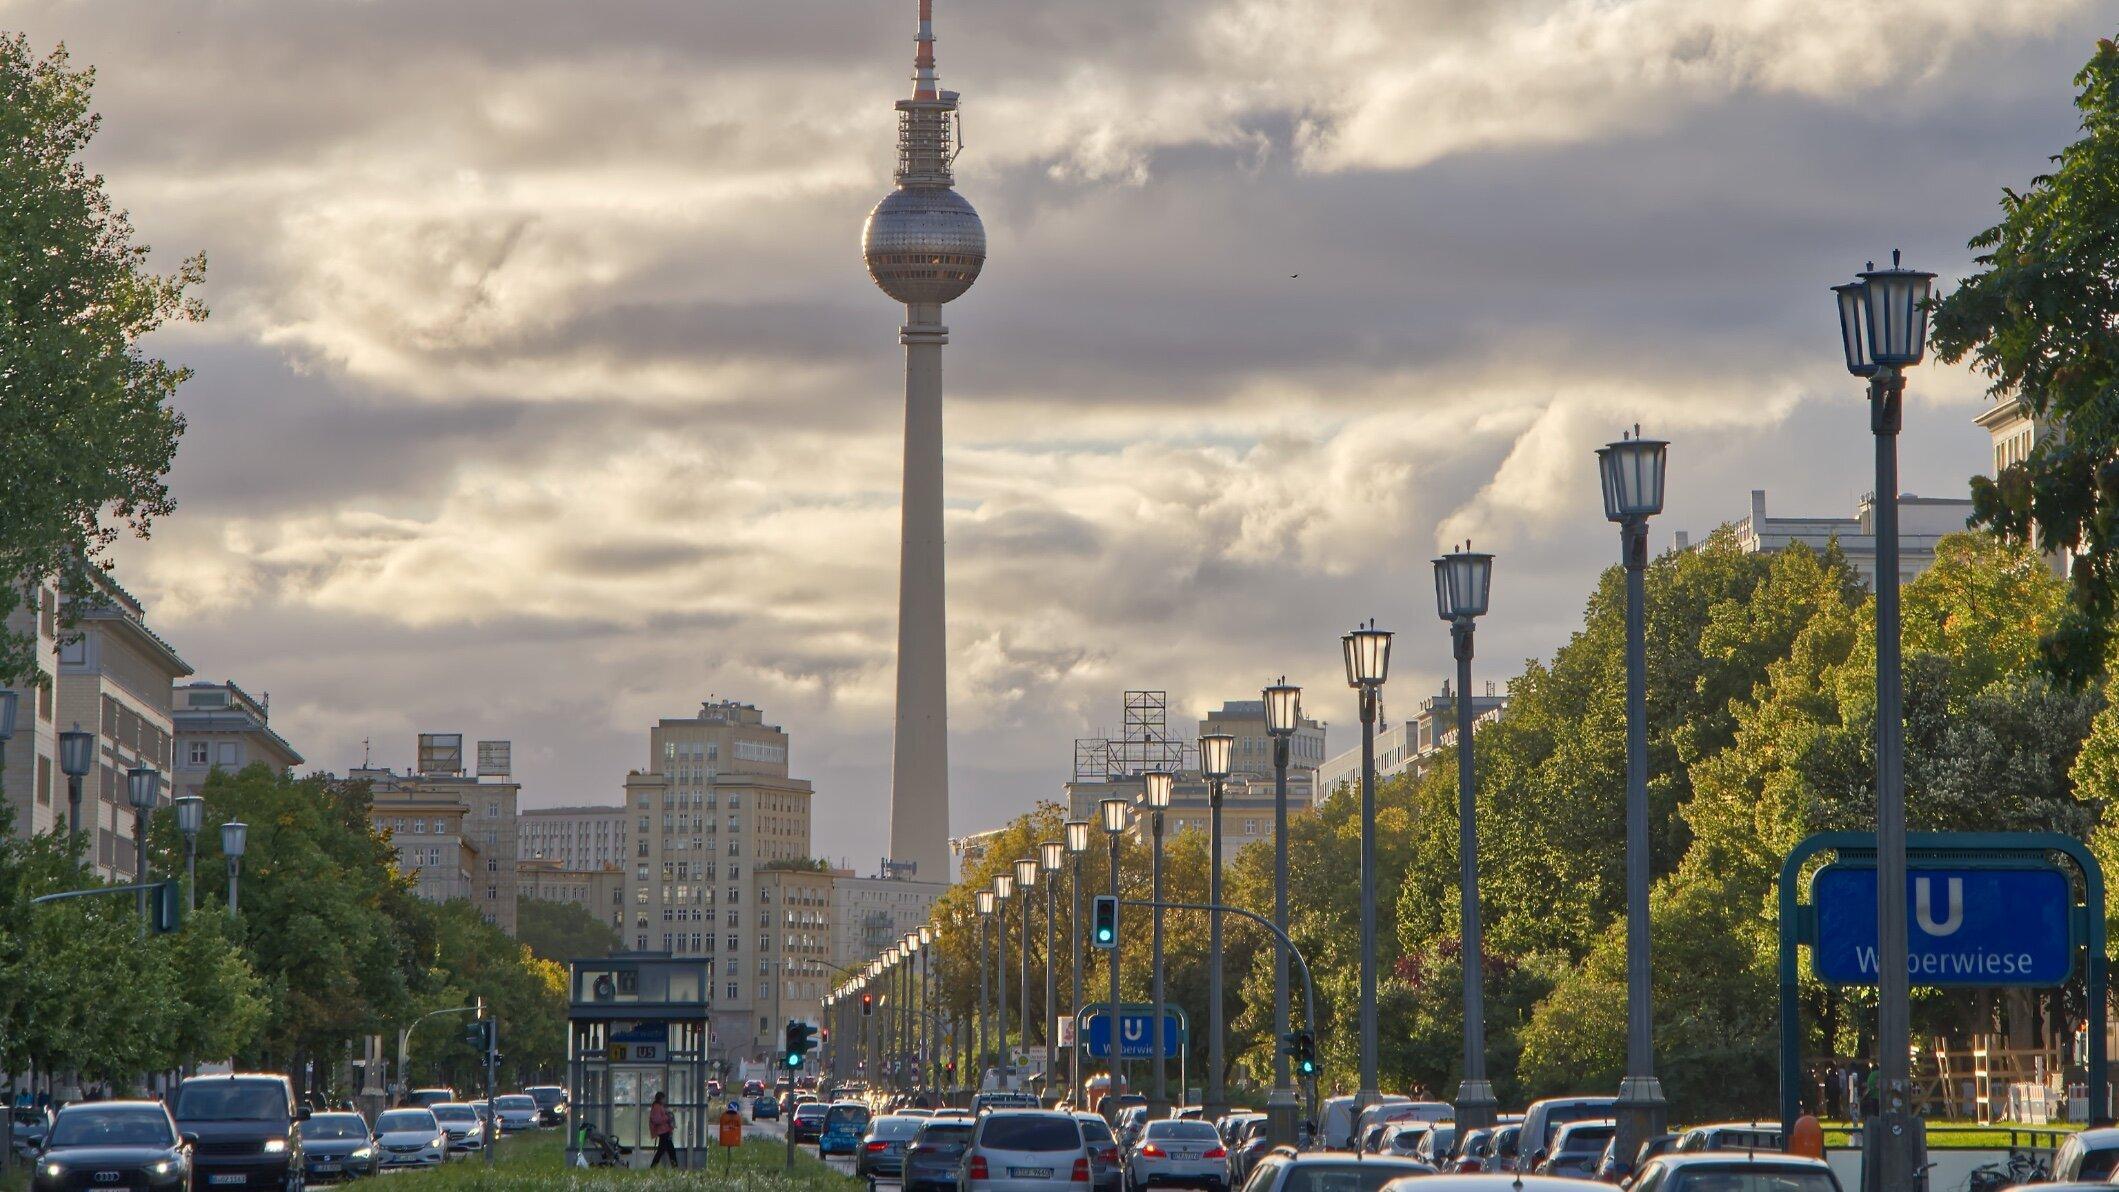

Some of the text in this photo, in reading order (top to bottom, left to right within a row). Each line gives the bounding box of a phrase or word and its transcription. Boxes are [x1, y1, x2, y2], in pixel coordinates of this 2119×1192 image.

[1915, 877, 1964, 937] U
[1856, 946, 2033, 974] Wberwiese
[1124, 1019, 1142, 1041] U
[1103, 1043, 1167, 1055] Wberwie
